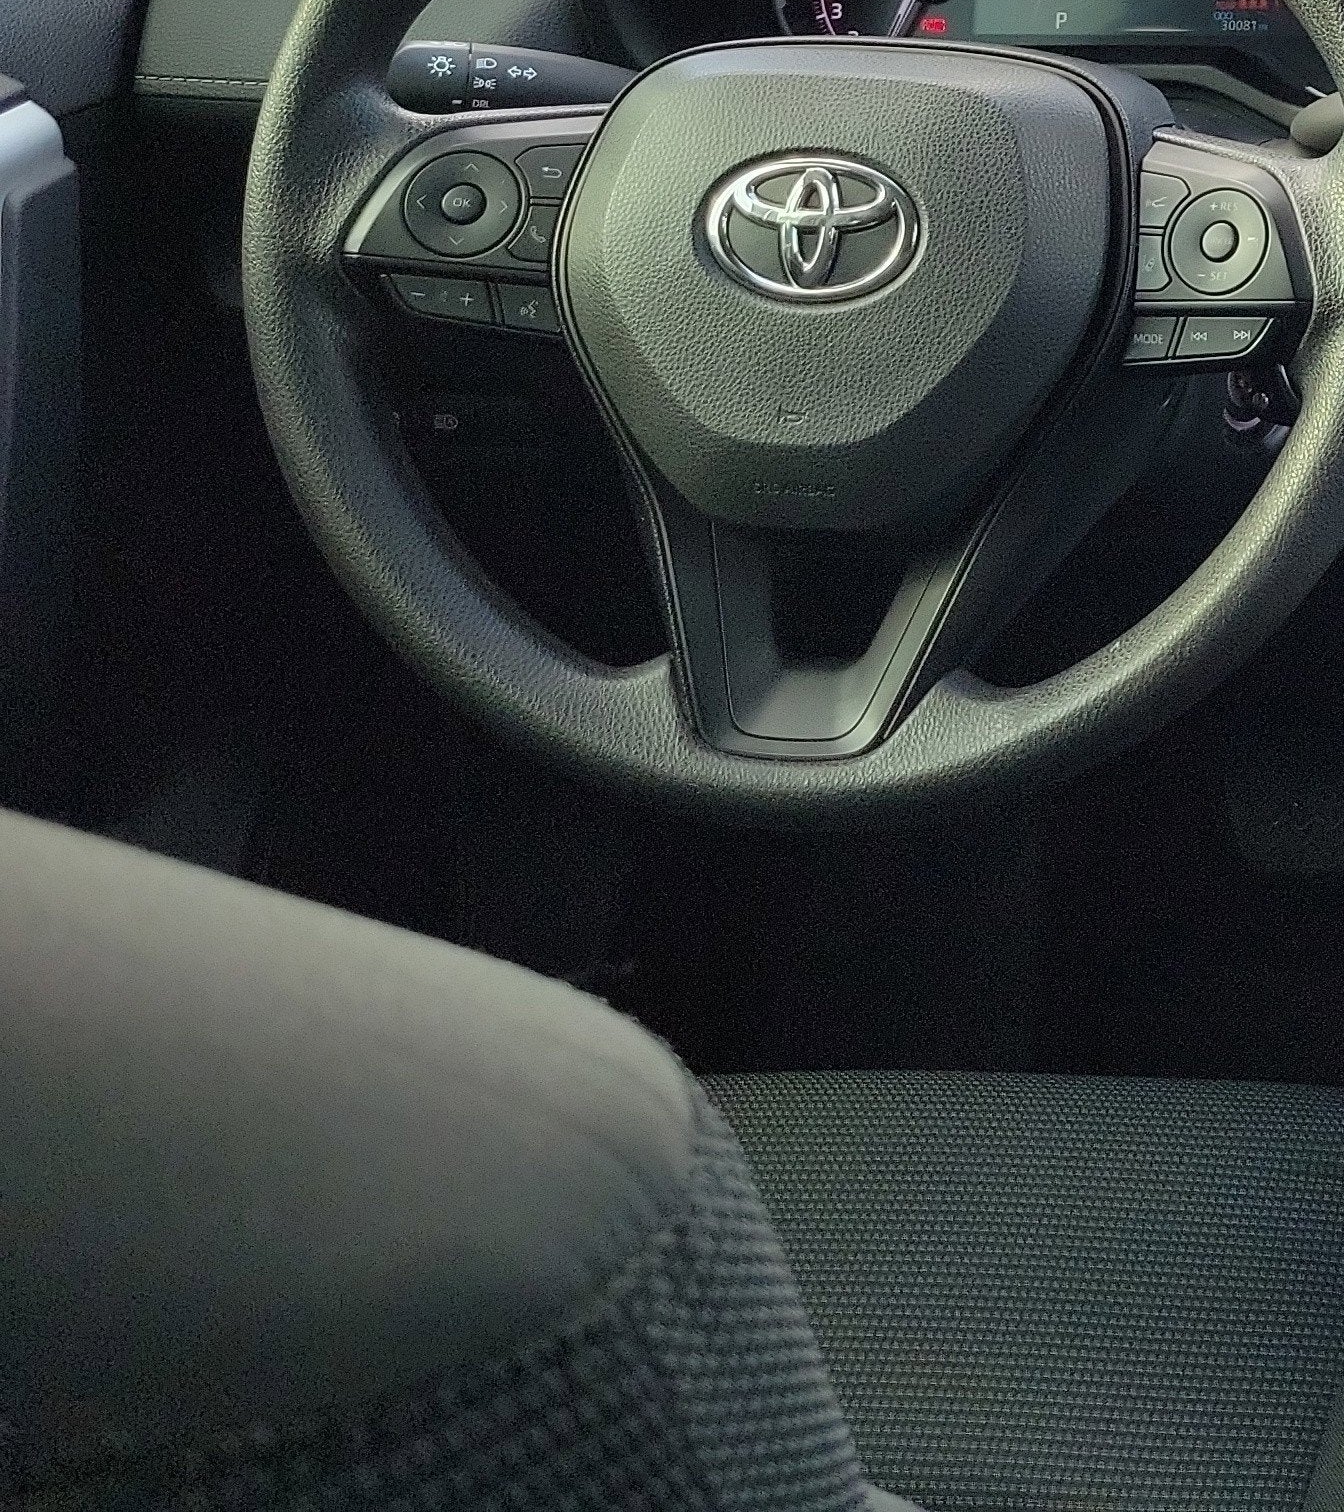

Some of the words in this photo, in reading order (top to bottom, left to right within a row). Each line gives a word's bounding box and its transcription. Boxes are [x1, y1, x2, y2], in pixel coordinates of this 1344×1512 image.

[831, 3, 842, 19] 3
[1056, 12, 1067, 29] P
[472, 100, 490, 108] DRL
[453, 197, 471, 207] OK
[1134, 334, 1163, 344] MODE
